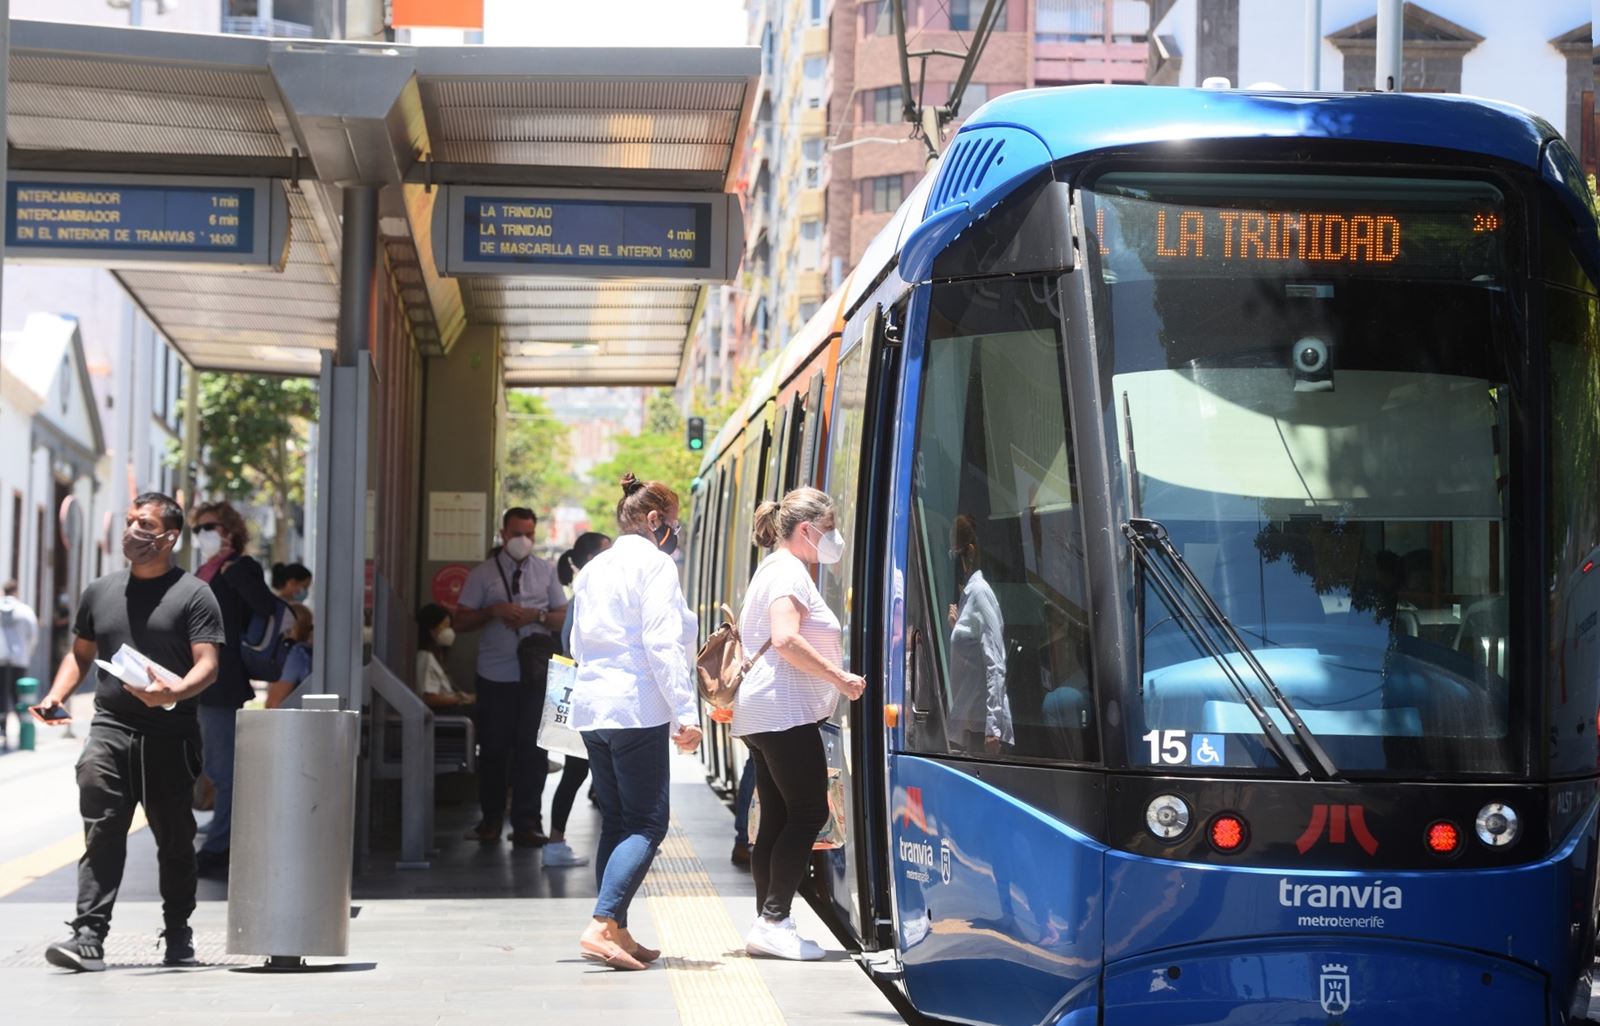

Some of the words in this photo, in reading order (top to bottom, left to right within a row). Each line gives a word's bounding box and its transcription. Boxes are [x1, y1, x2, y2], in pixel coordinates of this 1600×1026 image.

[17, 189, 120, 205] INTERCAMBIADOR
[211, 196, 218, 207] 1
[219, 196, 239, 208] min
[17, 208, 120, 223] INTERCAMBIADOR
[208, 214, 217, 226] 6
[218, 214, 239, 226] min
[480, 205, 497, 217] LA
[502, 206, 553, 219] TRINIDAD
[17, 226, 35, 240] EN
[38, 227, 52, 240] EL
[57, 228, 109, 241] INTERIOR
[114, 229, 129, 242] DE
[135, 229, 196, 243] TRANVIAS
[209, 233, 236, 246] 14:00
[480, 223, 497, 236] LA
[501, 224, 553, 237] TRINIDAD
[667, 229, 675, 240] 4
[677, 229, 696, 240] min
[1157, 210, 1204, 257] LA
[1219, 211, 1401, 261] TRINIDAD
[480, 241, 496, 254] DE
[500, 242, 574, 256] MASCARILLA
[579, 244, 595, 256] EN
[598, 244, 612, 257] EL
[667, 248, 693, 260] 14:00
[1142, 729, 1188, 765] 15
[899, 835, 934, 867] tranvía
[1279, 878, 1403, 910] tranvía
[1297, 915, 1385, 929] metrotenerife
